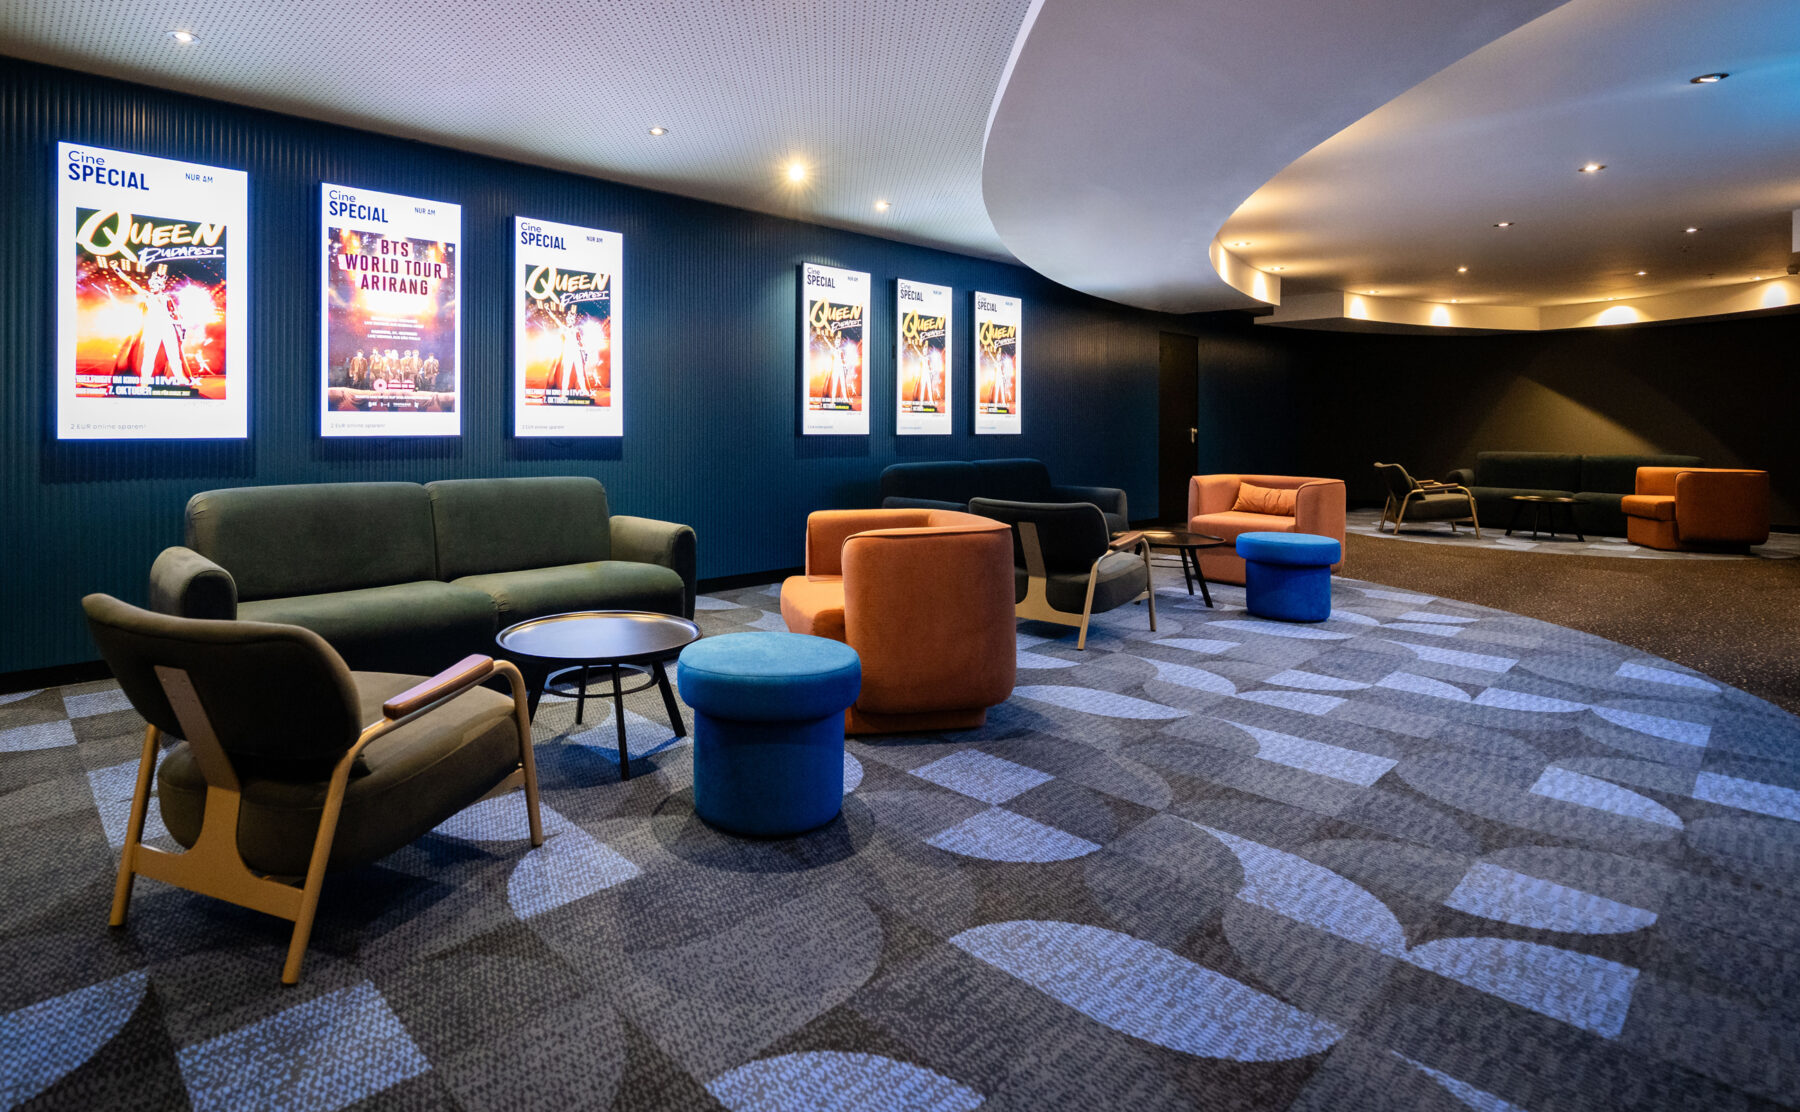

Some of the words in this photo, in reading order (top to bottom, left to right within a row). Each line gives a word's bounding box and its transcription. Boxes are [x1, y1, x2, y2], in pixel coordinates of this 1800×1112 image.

[68, 150, 105, 166] Cine
[68, 163, 150, 191] SPECIAL
[185, 172, 201, 182] NUR
[202, 175, 214, 184] AM
[329, 190, 356, 203] Cine
[329, 200, 389, 223] SPECIAL
[414, 207, 426, 215] NUR
[76, 208, 226, 263] QUEEN
[520, 222, 542, 233] Cine
[381, 239, 409, 257] BTS
[520, 231, 567, 251] SPECIAL
[138, 245, 225, 267] BUDAPEST
[345, 253, 399, 275] WORLD
[405, 260, 442, 280] TOUR
[360, 274, 428, 296] ARIRANG
[525, 264, 610, 305] QUEEN
[807, 274, 836, 289] SPECIAL
[900, 289, 924, 302] SPECIAL
[809, 298, 864, 332] QUEEN
[977, 301, 997, 313] SPECIAL
[902, 310, 946, 340] QUEEN
[979, 319, 1017, 347] QUEEN
